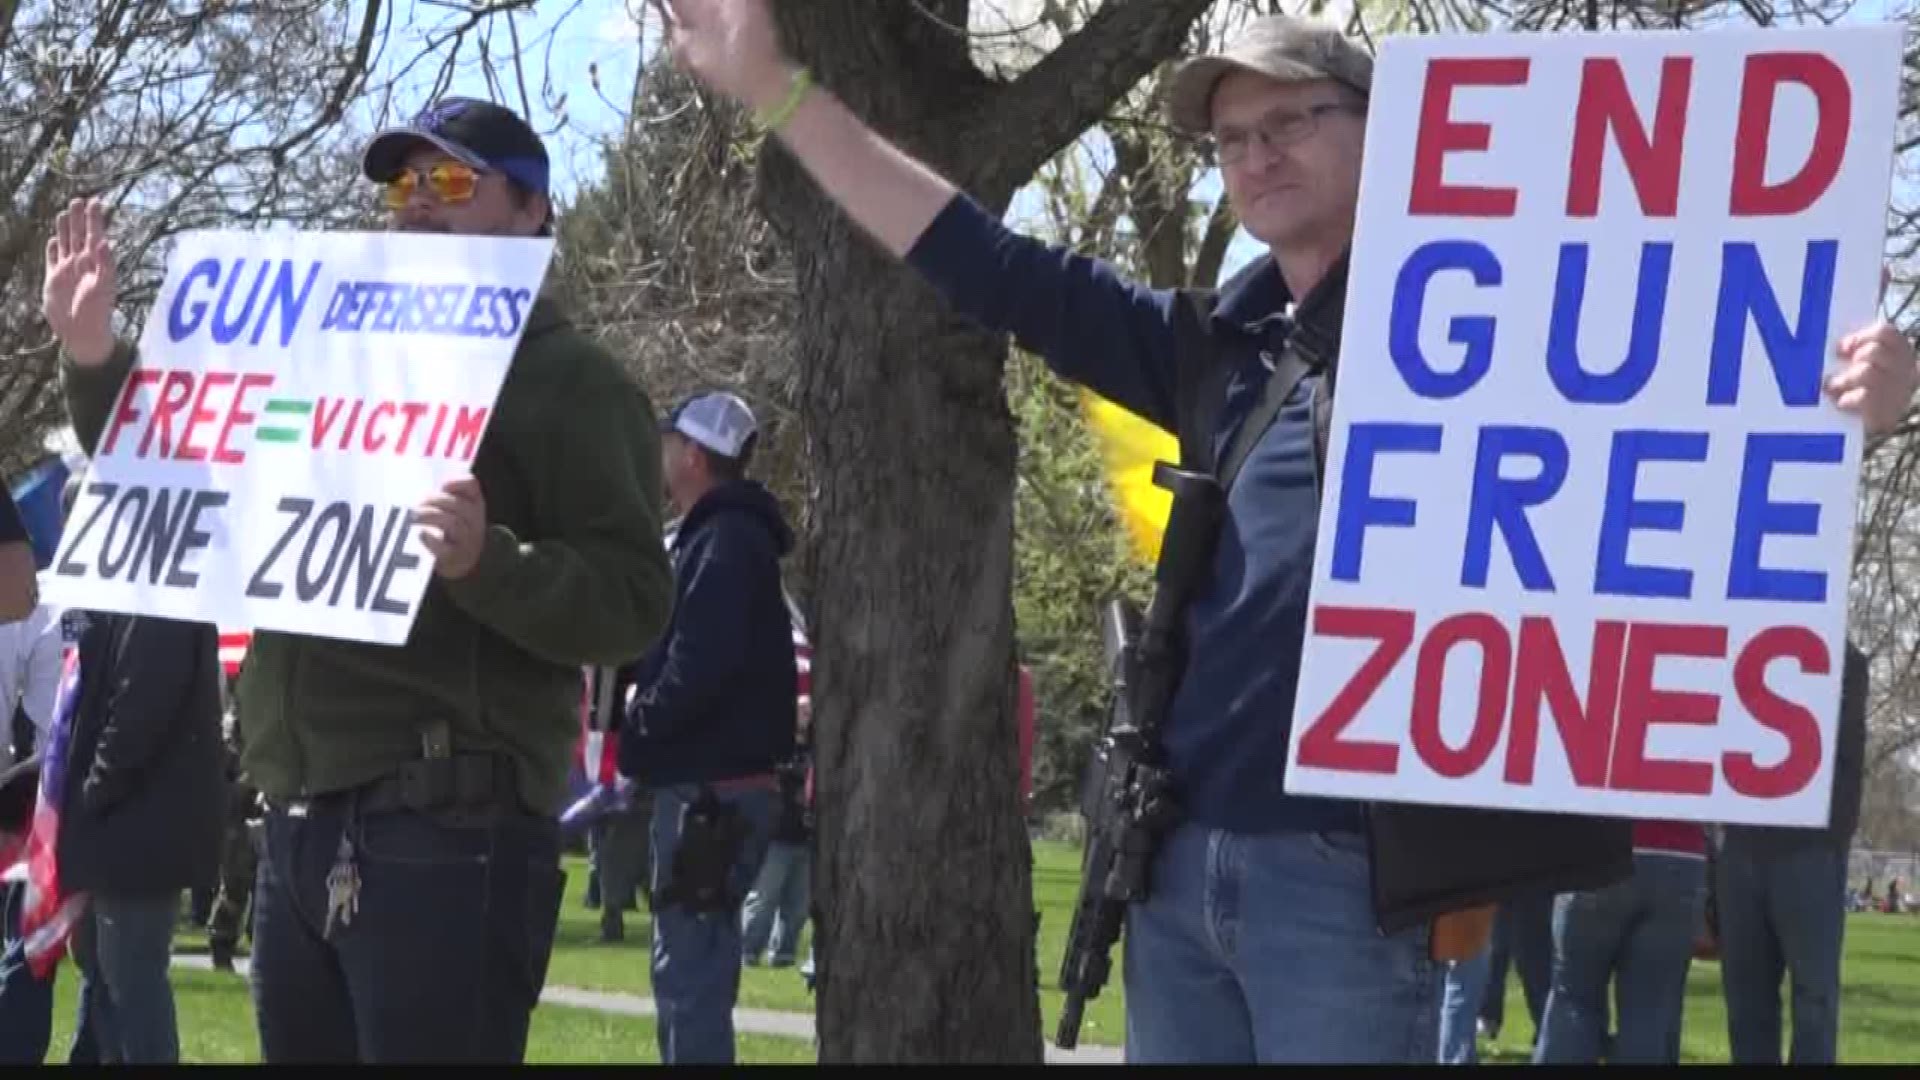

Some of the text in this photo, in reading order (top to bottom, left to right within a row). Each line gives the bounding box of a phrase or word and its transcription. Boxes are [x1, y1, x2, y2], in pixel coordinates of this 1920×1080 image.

[1408, 51, 1850, 217] END
[168, 259, 530, 347] GUN DEFENSELESS
[1388, 239, 1839, 408] GUN
[103, 369, 274, 464] FREE
[311, 399, 488, 460] VICTIM
[57, 482, 421, 616] ZONE ZONE
[1330, 421, 1846, 603] FREE
[1296, 605, 1831, 799] ZONES
